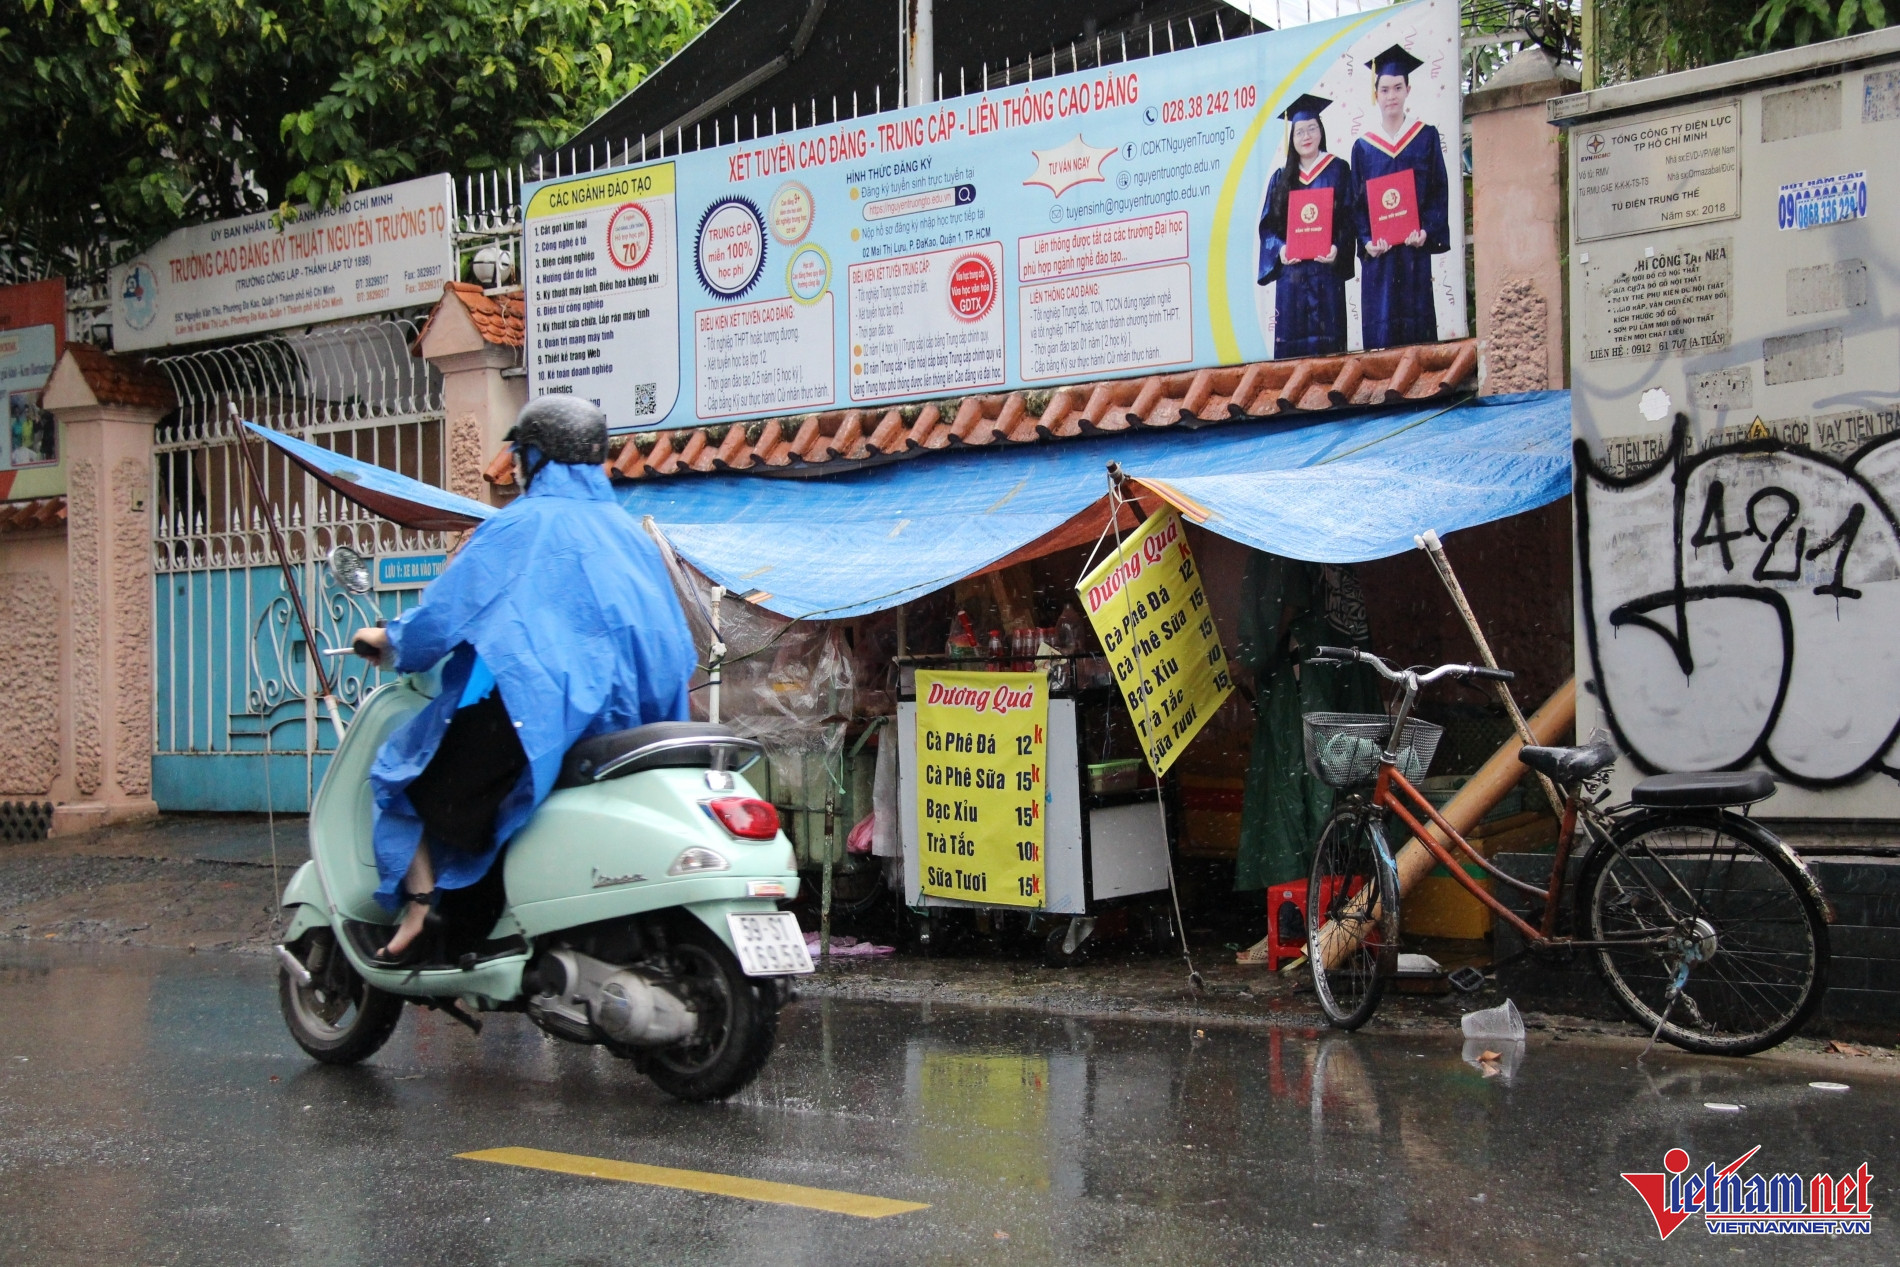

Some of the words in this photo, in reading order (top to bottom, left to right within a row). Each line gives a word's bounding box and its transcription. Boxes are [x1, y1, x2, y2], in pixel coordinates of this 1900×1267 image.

[1162, 98, 1203, 124] 028.38
[1206, 90, 1229, 116] 242
[1234, 85, 1256, 110] 109
[729, 148, 751, 183] XÉT
[755, 140, 795, 176] TUYỂN
[800, 138, 826, 169] CAO
[830, 127, 867, 162] ĐẲNG
[878, 118, 924, 153] TRUNG
[928, 106, 956, 143] CẤP
[968, 97, 998, 136] LIÊN
[1003, 88, 1053, 128] THÔNG
[1059, 83, 1090, 118] CAO
[1094, 71, 1138, 111] ĐẲNG
[1612, 130, 1638, 145] TỔNG
[1640, 128, 1668, 139] CÔNG
[1671, 124, 1682, 134] TY
[1686, 119, 1708, 132] ĐIỆN
[1711, 116, 1732, 129] LỰC
[1634, 143, 1646, 152] TP
[1648, 137, 1662, 149] HỒ
[1664, 134, 1681, 146] CHÍ
[1683, 132, 1708, 144] MINH
[846, 169, 866, 184] HÌNH
[868, 164, 892, 181] THỨC
[894, 160, 918, 176] ĐĂNG
[921, 156, 932, 171] KÝ
[1134, 158, 1220, 186] nguyentruongto.edu.vn
[339, 200, 351, 215] HỒ
[354, 196, 369, 211] CHÍ
[371, 194, 393, 208] MINH
[550, 189, 569, 208] CÁC
[572, 183, 605, 204] NGÀNH
[608, 178, 628, 198] ĐÀO
[632, 176, 652, 195] TẠO
[1066, 185, 1210, 220] tuyensinh@nguyentruongto.edu.vn
[1612, 200, 1623, 212] TỦ
[1626, 198, 1646, 210] ĐIỆN
[1648, 192, 1679, 205] TRUNG
[1682, 187, 1700, 200] THẾ
[1661, 210, 1683, 221] Năm
[1686, 208, 1699, 218] sx:
[1702, 203, 1726, 215] 2018
[169, 250, 212, 284] TRƯỜNG
[216, 248, 236, 275] CAO
[240, 238, 269, 270] ĐẲNG
[272, 232, 286, 263] KỸ
[289, 228, 324, 260] THUẬT
[328, 215, 373, 252] NGUYỄN
[376, 207, 426, 243] TRƯỜNG
[429, 202, 445, 238] TỘ
[709, 227, 735, 241] TRUNG
[737, 222, 752, 236] CẤP
[708, 248, 725, 262] miễn
[728, 241, 753, 260] 100%
[719, 267, 731, 280] học
[733, 263, 744, 278] phí
[960, 297, 982, 312] GDTX
[1087, 552, 1142, 615] Dương
[1142, 517, 1178, 566] Quá
[1104, 626, 1124, 653] Cà
[1146, 584, 1170, 612] Đá
[1178, 558, 1194, 584] 12
[1116, 654, 1134, 682] Cà
[1160, 609, 1187, 642] Sữa
[1190, 587, 1204, 612] 15
[1150, 656, 1180, 688] Xỉu
[1198, 615, 1214, 640] 15
[1160, 686, 1184, 722] Tắc
[1207, 644, 1222, 667] 10
[927, 683, 992, 712] Dương
[993, 684, 1034, 714] Quá
[1171, 704, 1199, 742] Tươi
[1212, 670, 1228, 694] 15
[927, 731, 942, 751] Cà
[945, 732, 973, 757] Phê
[977, 734, 996, 755] Đá
[927, 765, 942, 784] Cà
[945, 766, 972, 787] Phê
[976, 768, 1006, 790] Sữa
[927, 799, 951, 824] Bạc
[954, 800, 978, 823] Xỉu
[927, 832, 947, 854] Trà
[950, 832, 975, 857] Tắc
[928, 866, 952, 889] Sữa
[956, 869, 987, 892] Tươi
